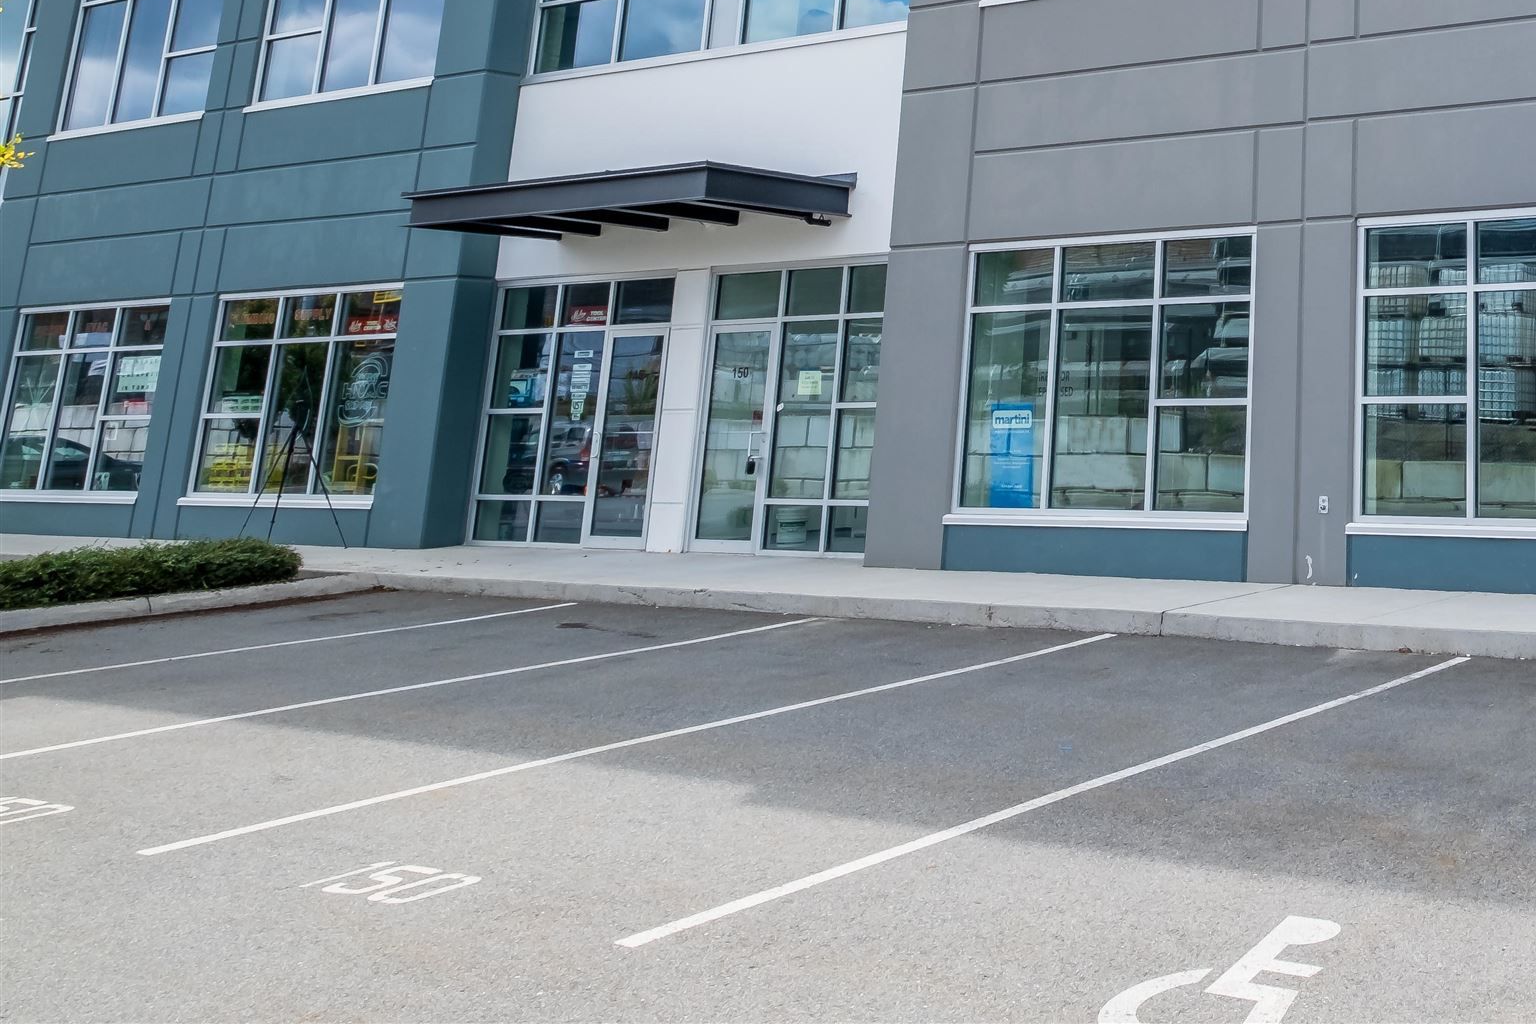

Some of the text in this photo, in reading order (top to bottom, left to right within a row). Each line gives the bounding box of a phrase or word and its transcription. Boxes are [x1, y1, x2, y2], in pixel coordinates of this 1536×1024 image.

[732, 367, 749, 379] 150
[341, 381, 389, 400] HVAC
[994, 414, 1030, 425] martini
[299, 861, 482, 904] 150
